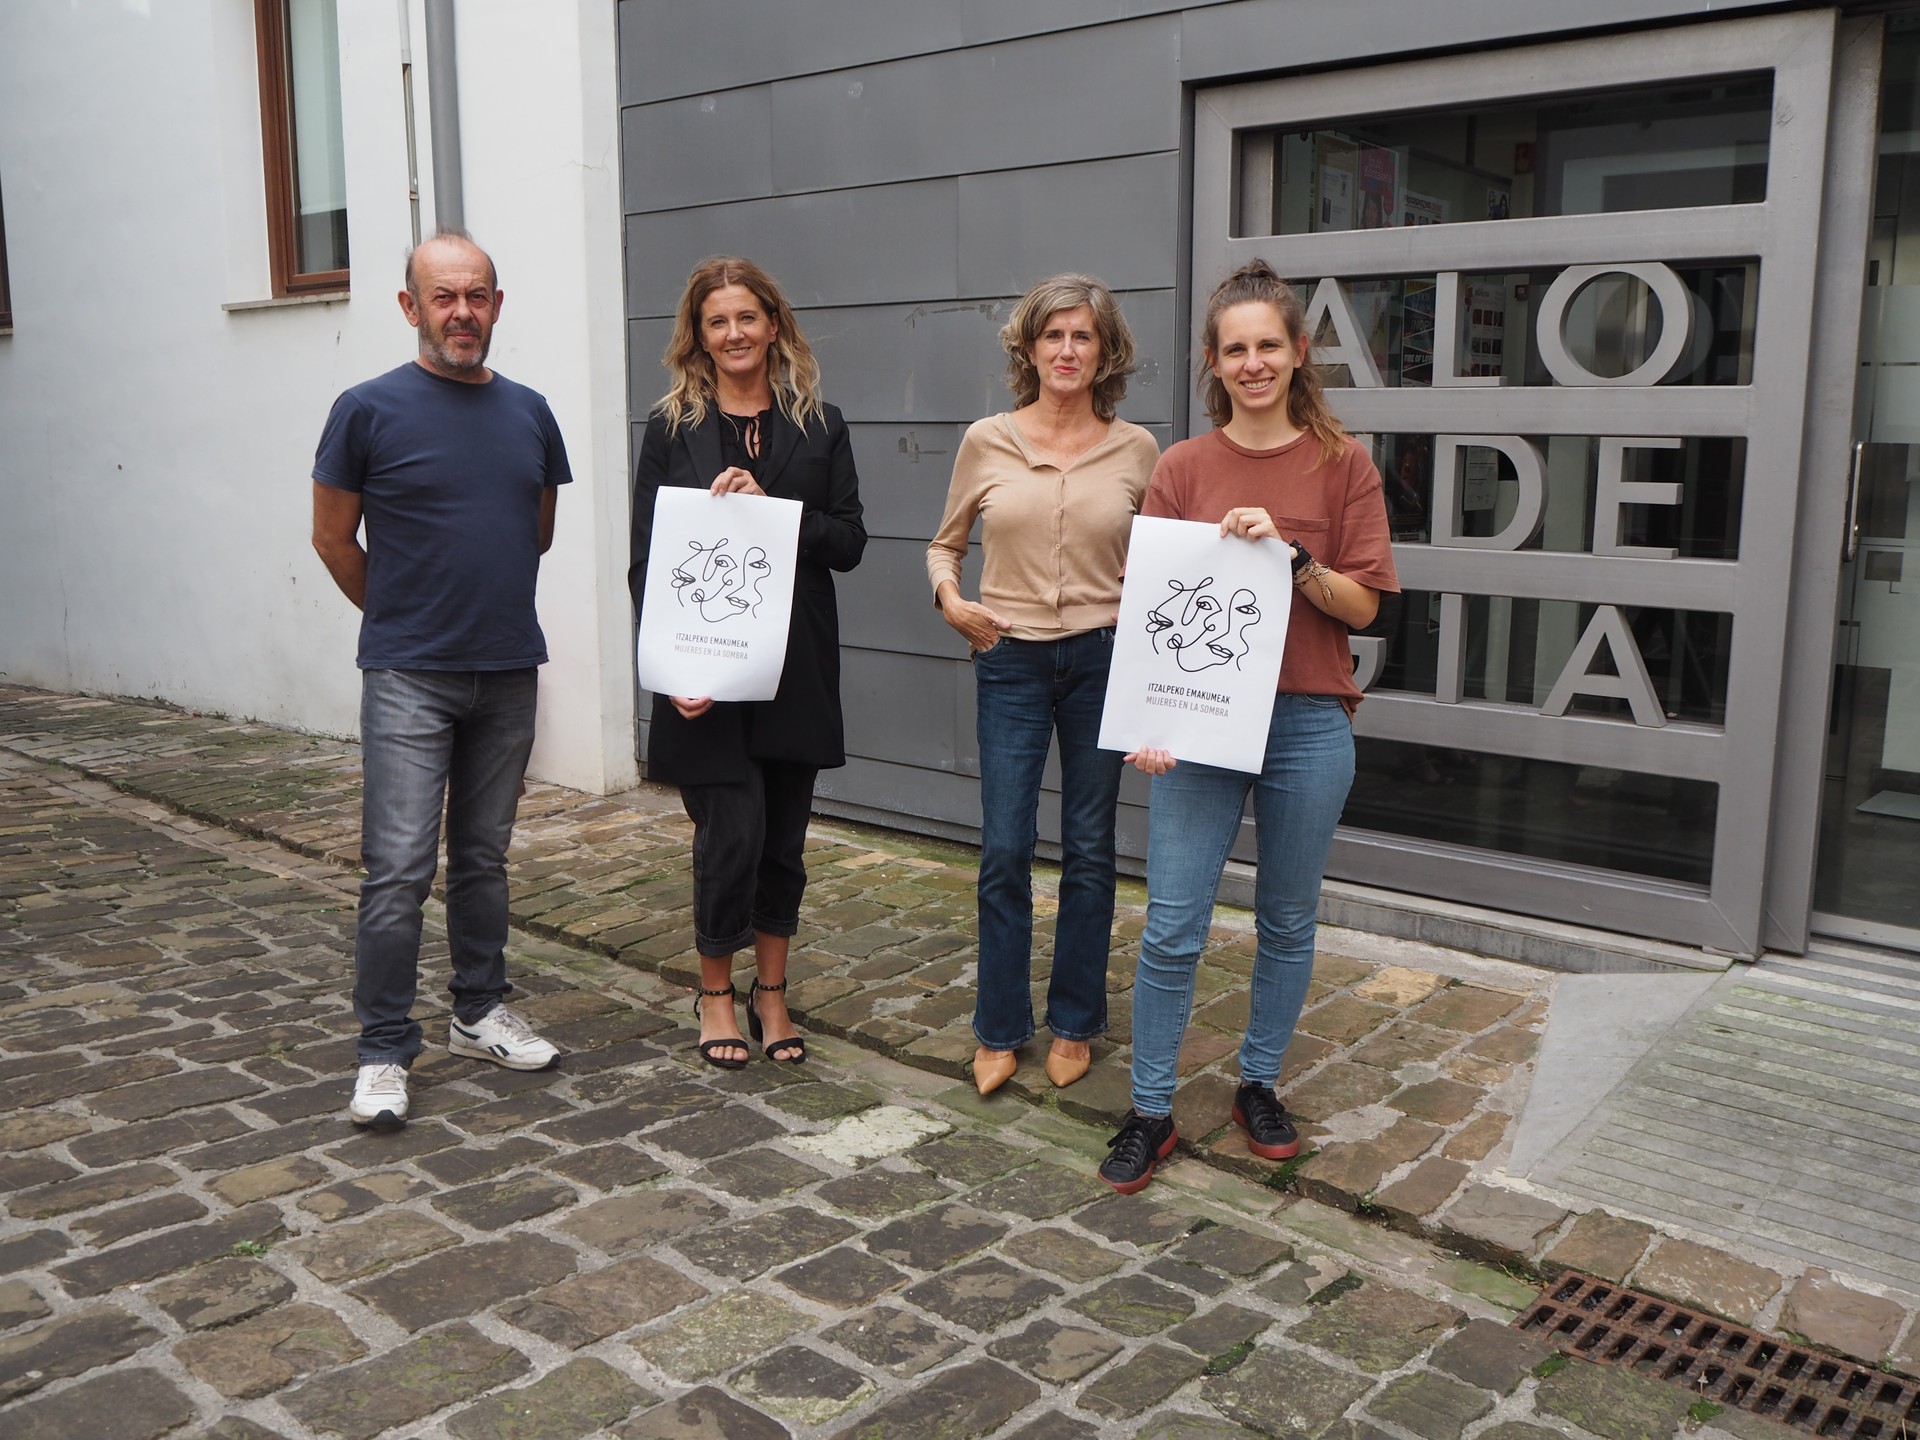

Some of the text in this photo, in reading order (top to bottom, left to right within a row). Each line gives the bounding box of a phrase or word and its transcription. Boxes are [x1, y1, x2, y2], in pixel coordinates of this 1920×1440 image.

[1356, 433, 1686, 559] DE
[675, 633, 749, 648] ITZALPEKO EMAKUMEAK
[674, 644, 748, 660] MUJERES EN LA SOMBRA
[1148, 683, 1231, 704] ITZALPEKO EMAKUMEAK
[1146, 696, 1229, 717] MUJERES EN LA SOMBRA
